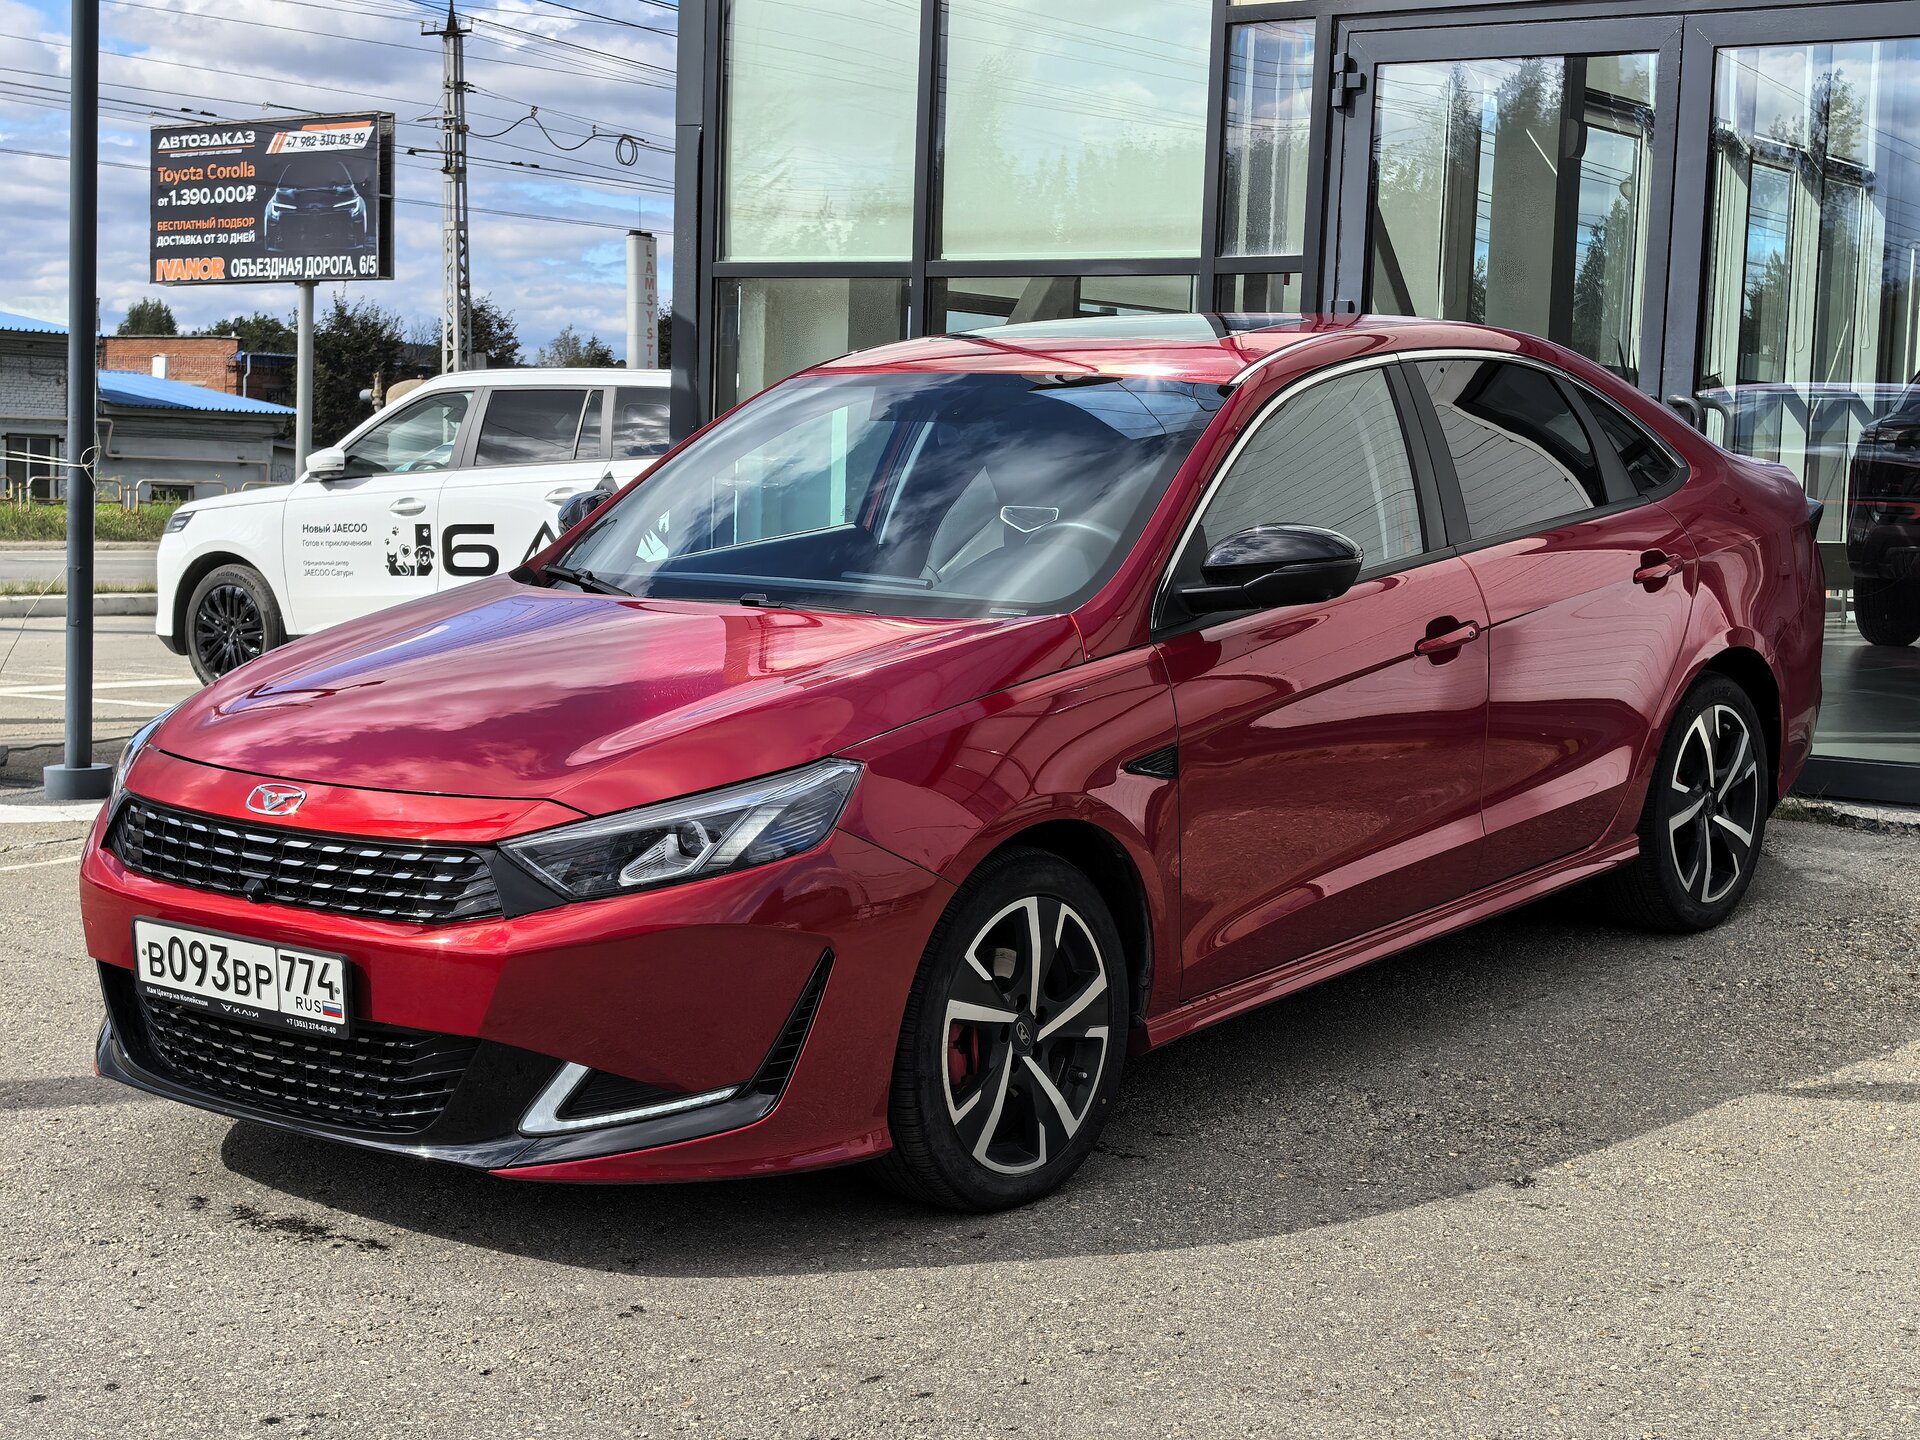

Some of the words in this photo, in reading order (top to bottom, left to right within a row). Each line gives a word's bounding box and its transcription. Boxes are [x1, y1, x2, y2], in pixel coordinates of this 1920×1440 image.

[158, 131, 255, 149] АВТОЗАКАЗ
[286, 137, 297, 147] +7
[301, 136, 316, 147] 982
[320, 134, 336, 146] 310
[157, 166, 203, 185] Toyota
[207, 161, 256, 179] Corolla
[158, 197, 169, 206] от
[157, 217, 216, 231] БЕСПЛАТНЫЙ
[218, 217, 255, 230] ПОДБОР
[157, 235, 202, 247] ДОСТАВКА
[203, 234, 216, 244] ОТ
[216, 233, 228, 244] 30
[230, 230, 255, 244] ДНЕЙ
[156, 257, 225, 281] IVANOR
[230, 257, 303, 279] ОБЪЕЗДНАЯ
[305, 255, 357, 279] ДОРОГА,
[359, 255, 377, 275] 6/5
[302, 523, 331, 534] Новый
[332, 523, 368, 533] JAECOO
[303, 569, 330, 577] JAECOO
[331, 569, 354, 578] Сатурн
[280, 955, 336, 1000] 774
[295, 996, 322, 1013] RUS
